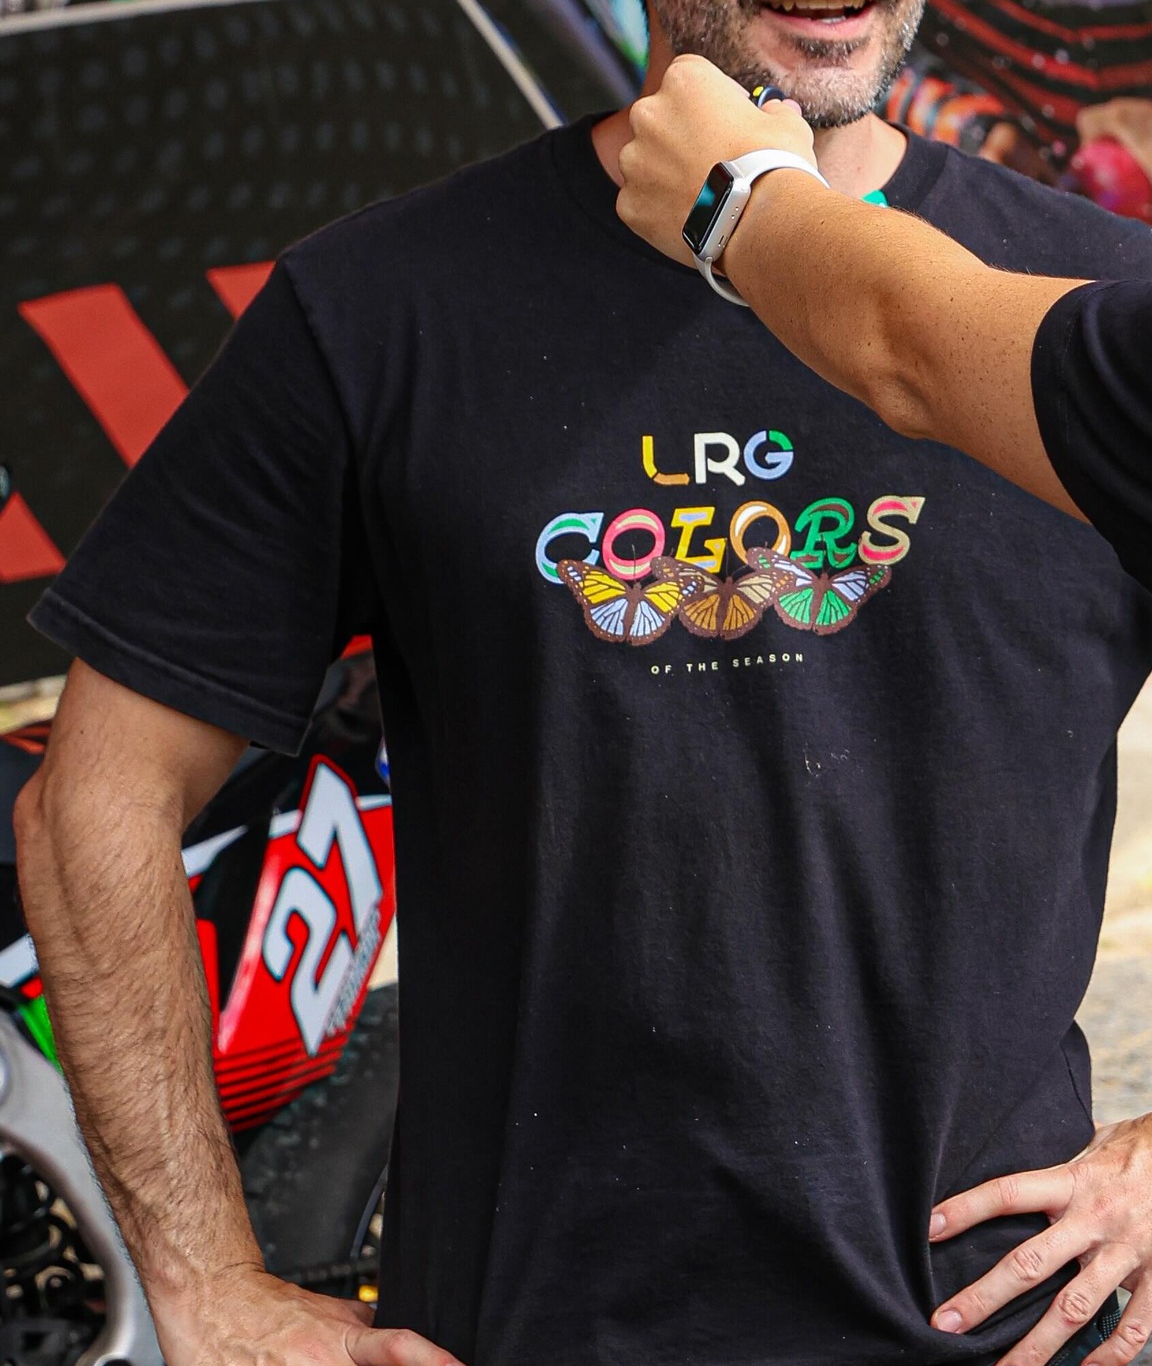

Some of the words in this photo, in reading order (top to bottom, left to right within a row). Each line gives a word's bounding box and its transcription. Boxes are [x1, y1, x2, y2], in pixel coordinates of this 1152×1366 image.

[641, 429, 794, 486] LRG
[535, 495, 926, 585] COLORS
[651, 665, 672, 674] OF
[686, 661, 718, 672] THE
[733, 653, 803, 667] SEASON
